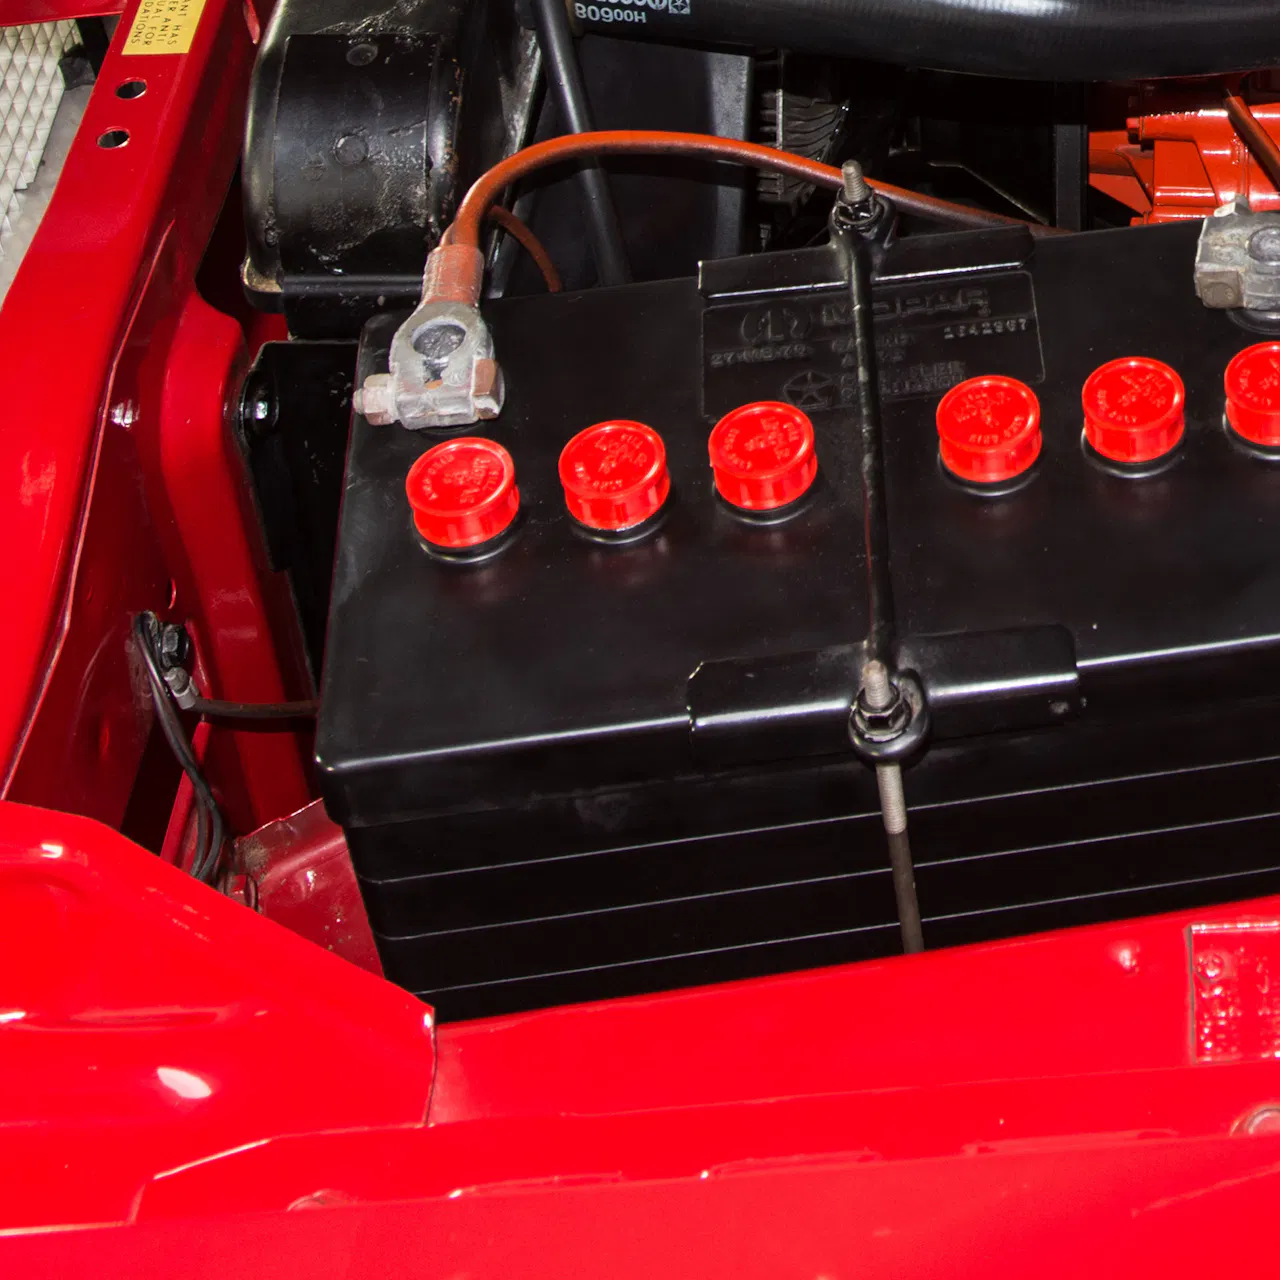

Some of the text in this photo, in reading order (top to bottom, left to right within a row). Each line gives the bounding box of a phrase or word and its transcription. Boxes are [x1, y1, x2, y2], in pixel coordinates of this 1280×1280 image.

[574, 3, 647, 23] H00608
[142, 26, 157, 45] FOR
[156, 18, 171, 41] ANTI
[167, 25, 182, 45] HAS
